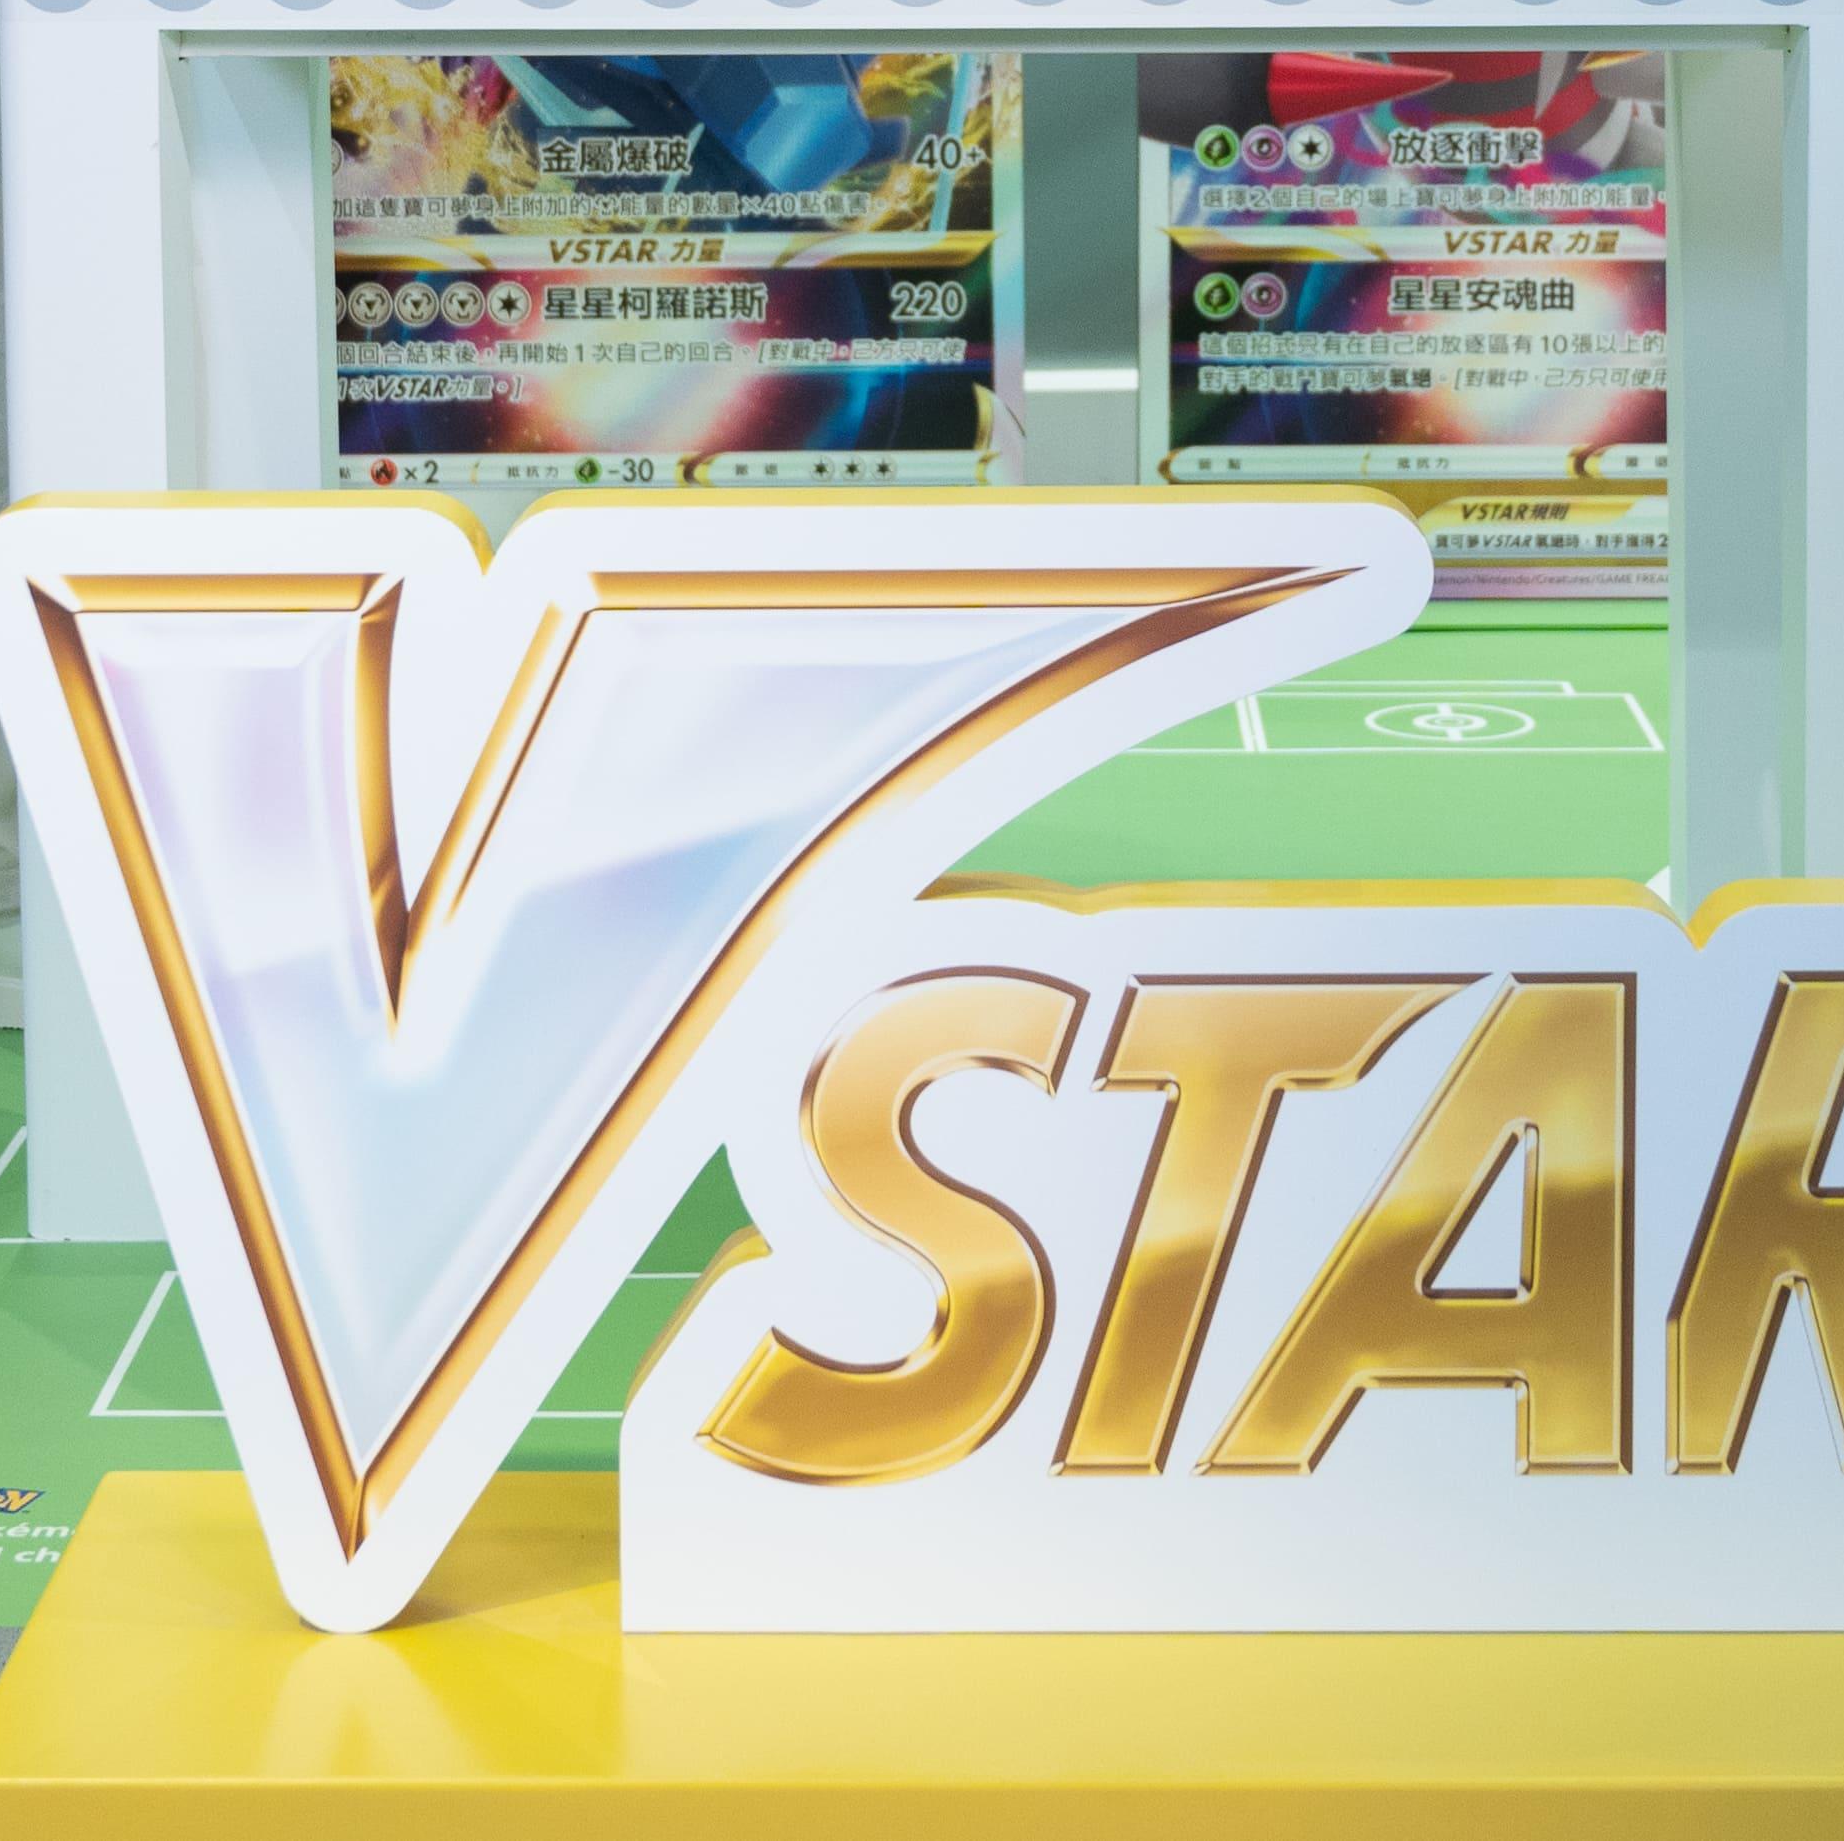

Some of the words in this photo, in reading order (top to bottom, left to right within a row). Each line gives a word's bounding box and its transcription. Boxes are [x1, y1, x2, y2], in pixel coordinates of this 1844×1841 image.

[542, 137, 691, 174] 金屬爆破
[1391, 130, 1541, 165] 放逐衝擊
[549, 237, 660, 265] VSTAR
[671, 237, 724, 264] 力量
[1444, 229, 1554, 256] VSTAR
[1564, 229, 1619, 255] 力量
[544, 285, 767, 320] 星星柯羅諾斯
[892, 284, 966, 320] 220
[1391, 278, 1574, 313] 星星安魂曲
